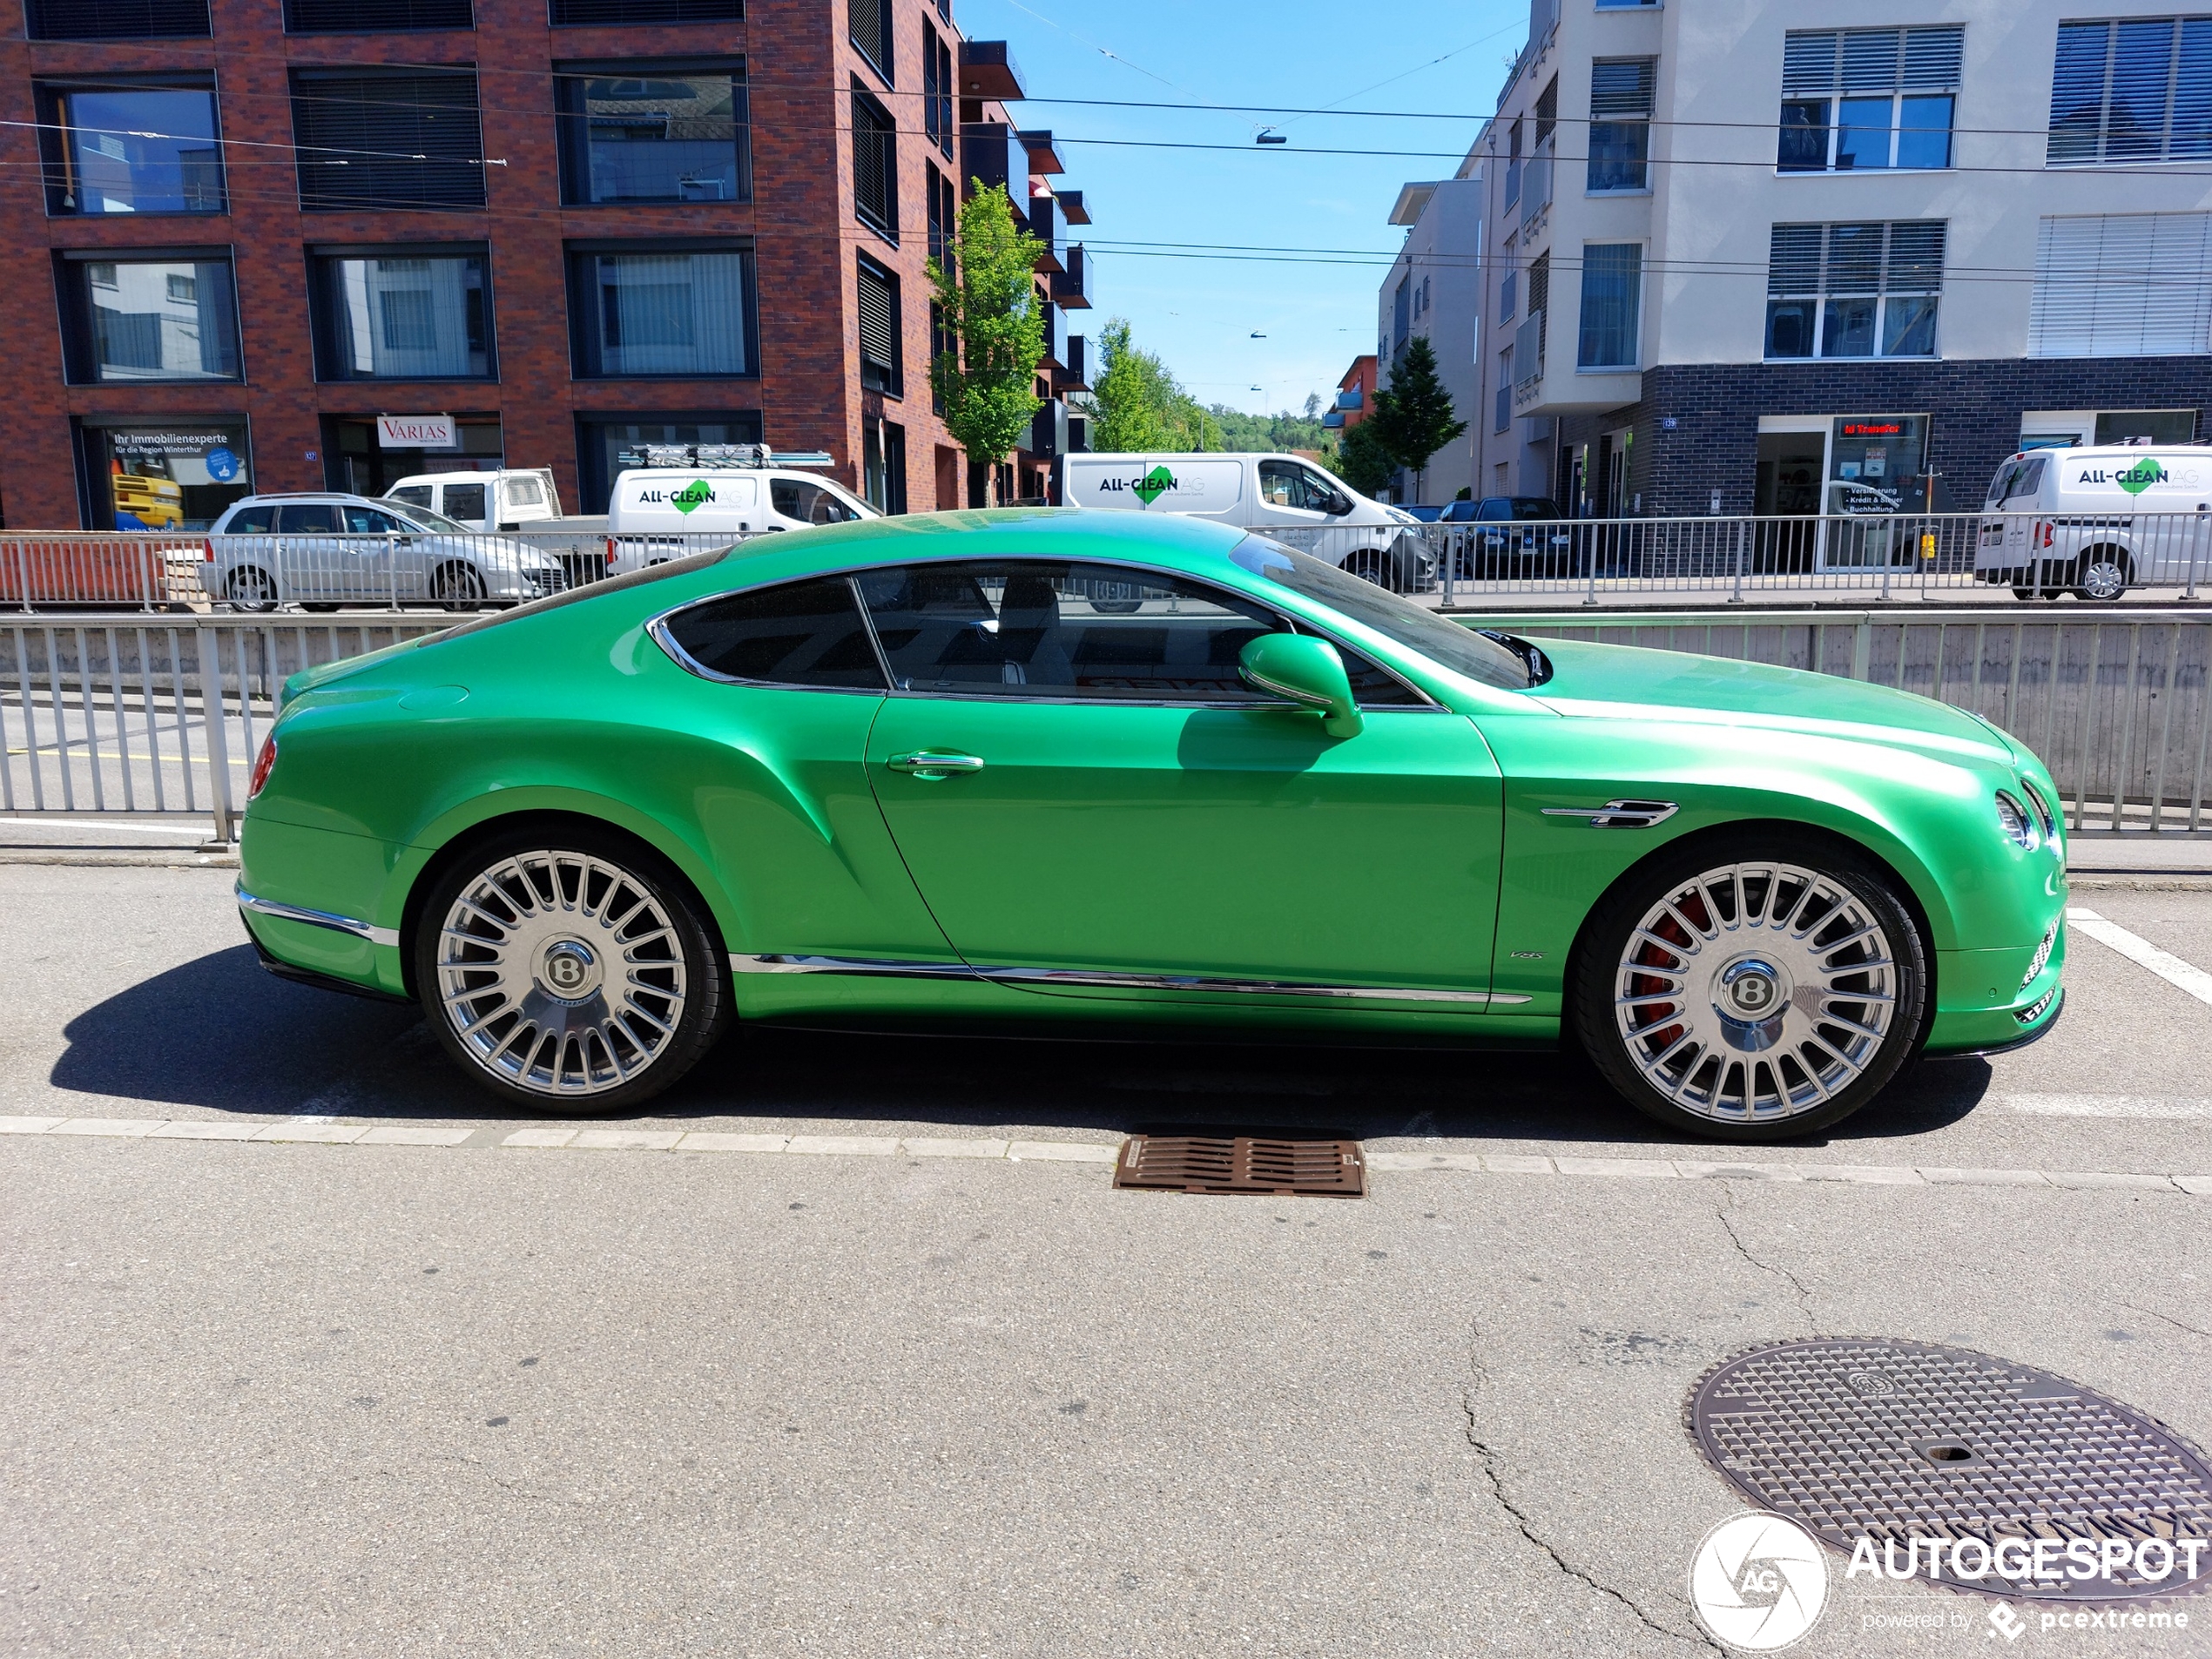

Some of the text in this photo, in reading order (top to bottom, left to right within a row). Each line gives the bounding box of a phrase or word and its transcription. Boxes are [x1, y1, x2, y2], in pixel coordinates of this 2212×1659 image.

[384, 420, 447, 439] VARIAS
[114, 434, 227, 445] Ihr Immobilienexperte
[139, 446, 162, 455] Region
[2079, 469, 2199, 483] ALL-CLEAN AG
[1099, 477, 1204, 491] ALL-CLEAN AG
[639, 490, 742, 503] ALL-CLEAN AG
[554, 958, 580, 982] B
[1737, 977, 1766, 1004] B
